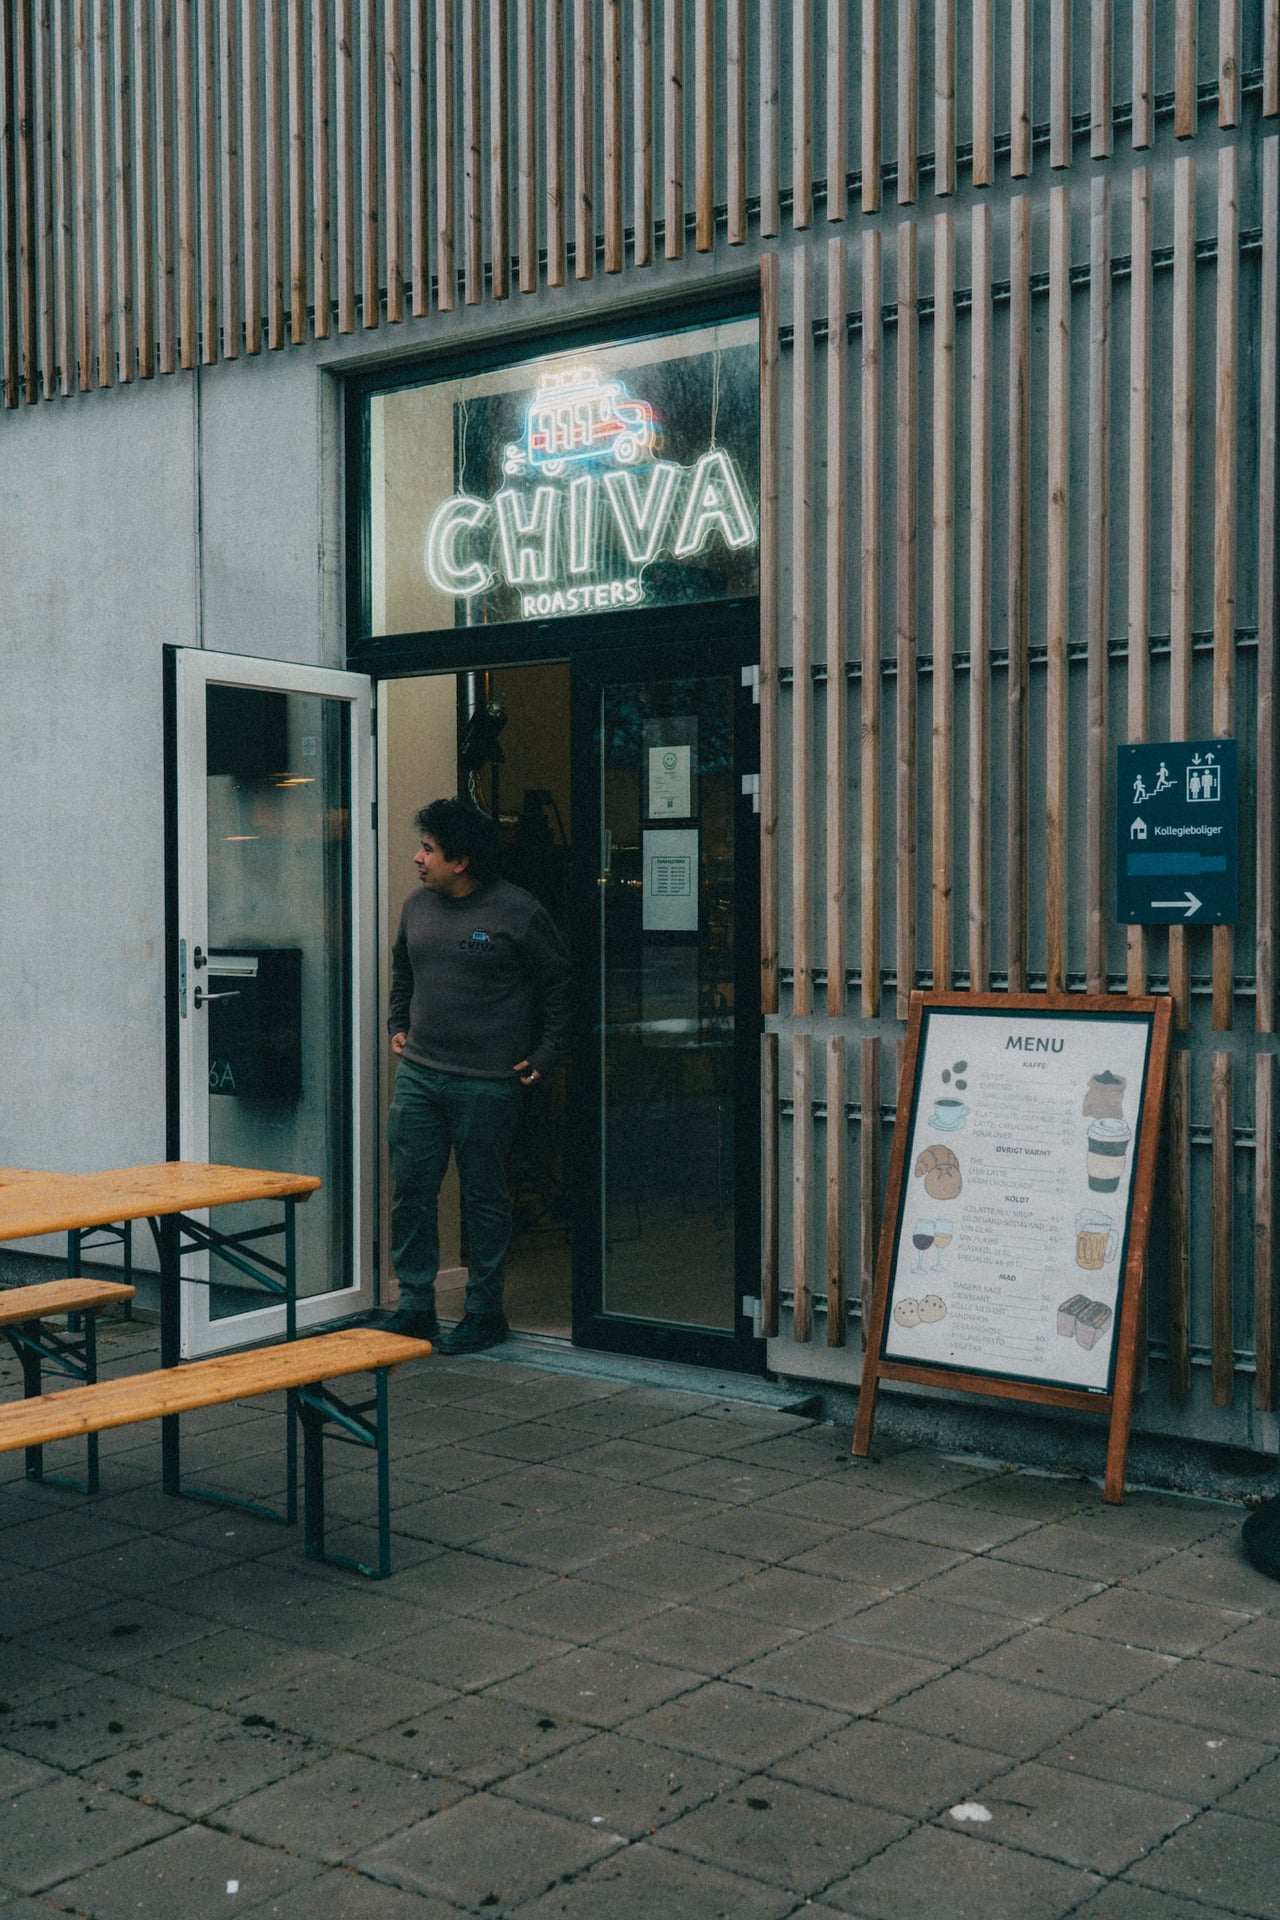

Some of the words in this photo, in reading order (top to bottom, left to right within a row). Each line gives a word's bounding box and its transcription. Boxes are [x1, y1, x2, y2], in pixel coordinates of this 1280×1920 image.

[426, 450, 754, 596] CHIVA
[523, 579, 639, 617] ROASTERS
[1154, 825, 1223, 838] Kollegieboliger
[1005, 1036, 1065, 1053] MENU
[1022, 1062, 1047, 1070] KAFFE
[995, 1146, 1023, 1154] ØVRIGT
[1024, 1148, 1051, 1156] VARMT
[1004, 1195, 1030, 1203] KOLDT
[998, 1273, 1017, 1281] MAD
